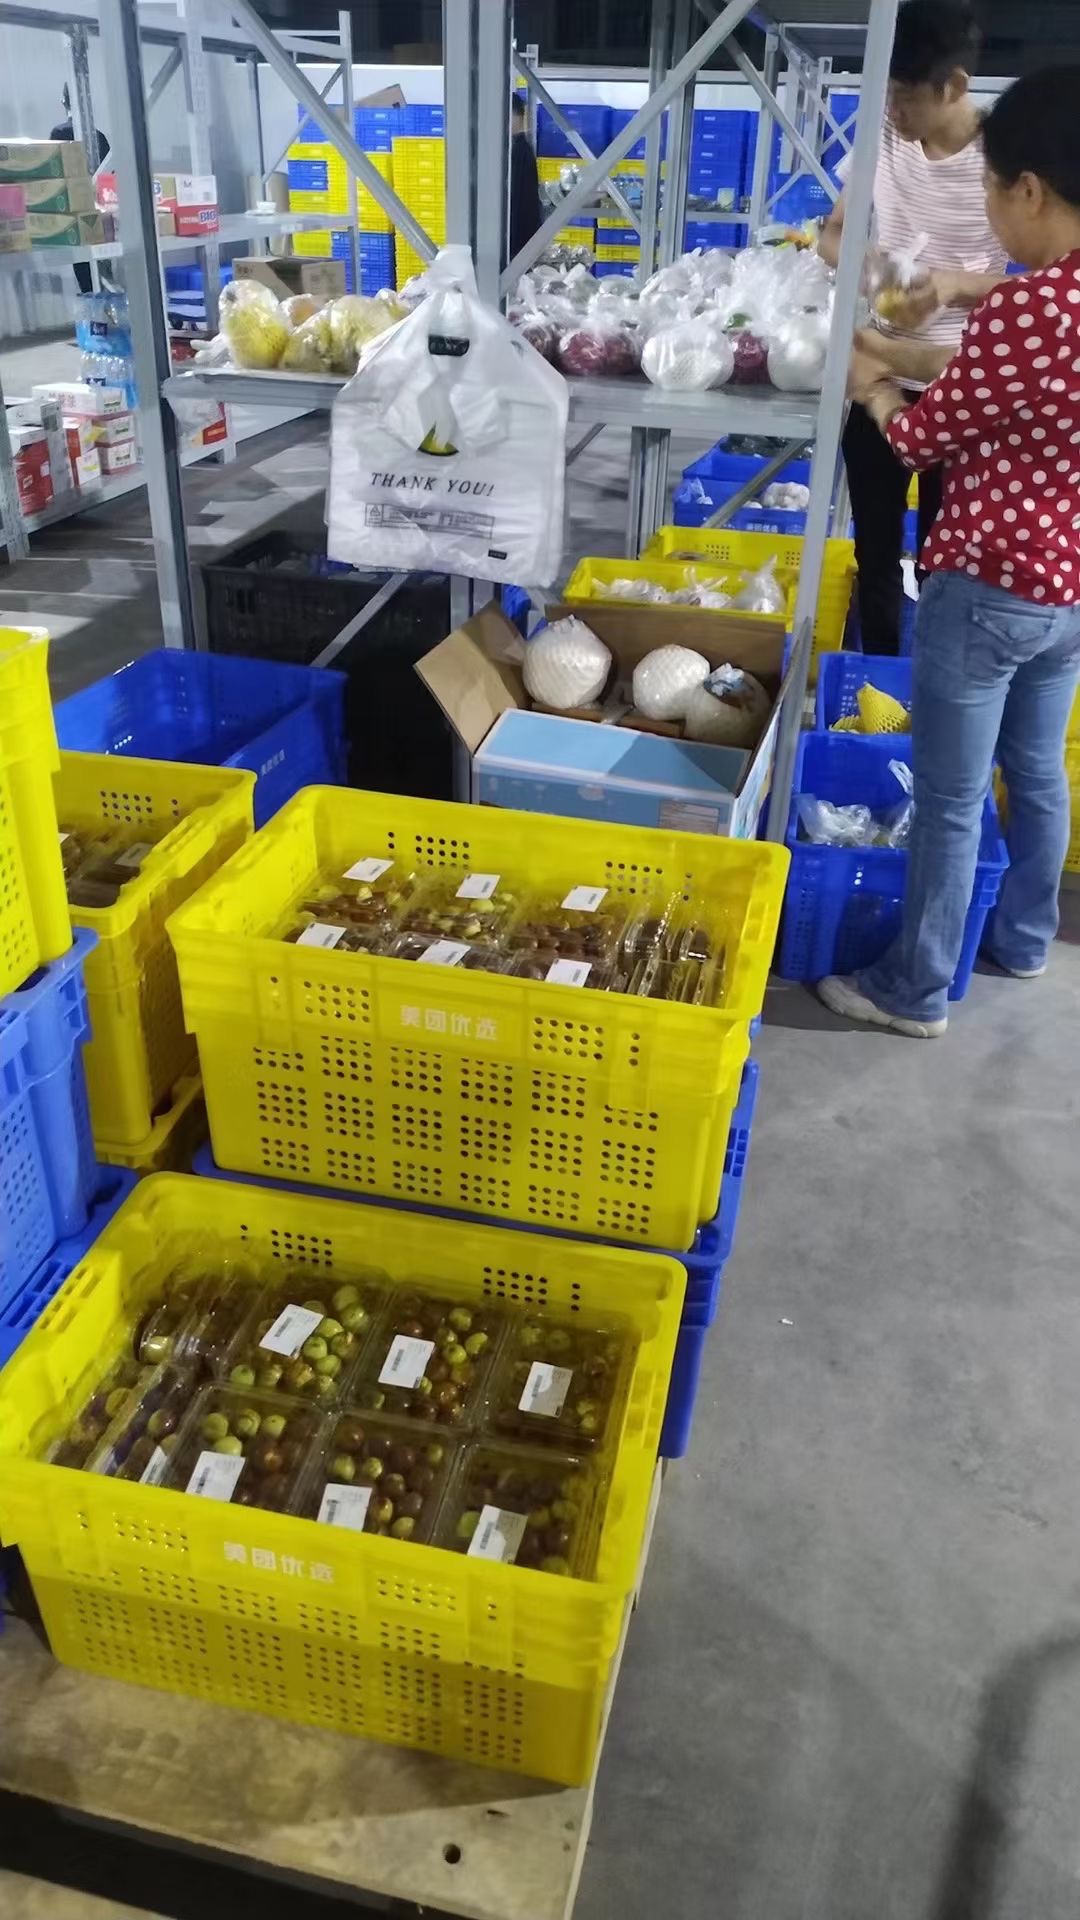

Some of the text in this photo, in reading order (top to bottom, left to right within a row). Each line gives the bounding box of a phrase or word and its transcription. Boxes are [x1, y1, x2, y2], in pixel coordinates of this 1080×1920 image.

[371, 472, 495, 496] THANK YOU!
[400, 1004, 497, 1041] 美团优选
